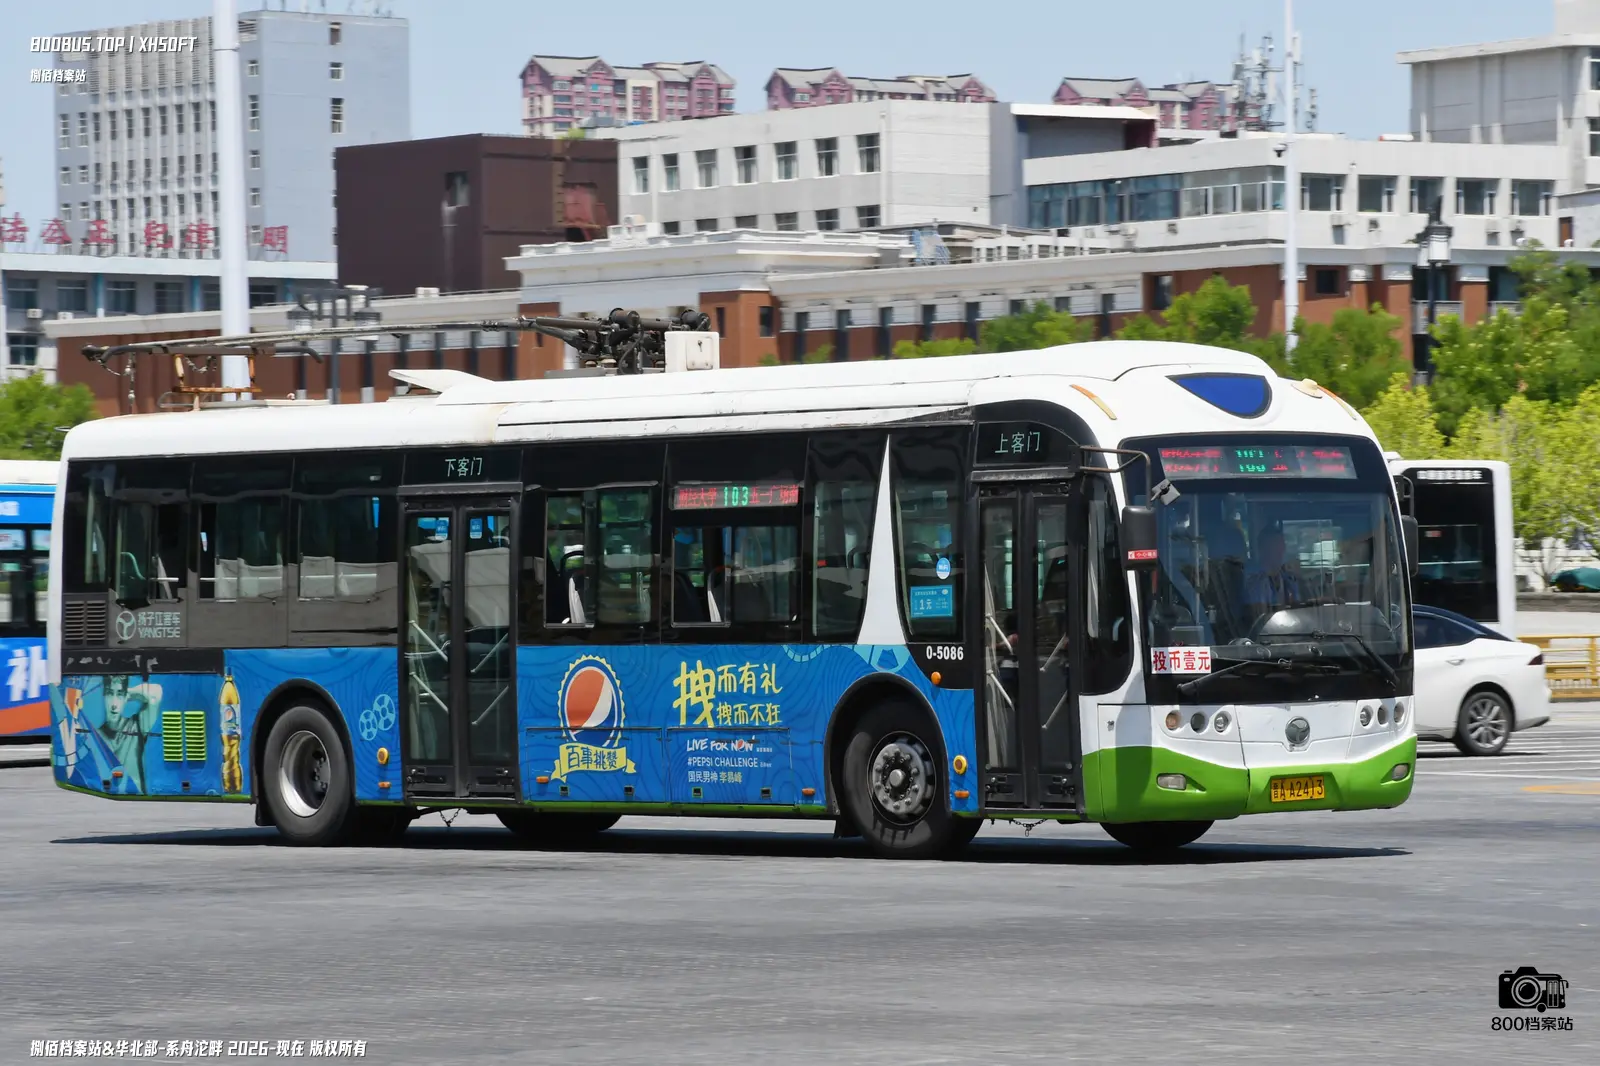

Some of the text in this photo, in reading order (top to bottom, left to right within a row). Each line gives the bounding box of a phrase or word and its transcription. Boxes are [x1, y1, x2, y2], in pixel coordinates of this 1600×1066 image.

[994, 431, 1041, 454] 上客门
[444, 456, 483, 477] 下客门
[723, 485, 749, 507] 103
[926, 645, 964, 660] 0-5086
[1153, 650, 1211, 671] 投币壹元
[686, 738, 708, 752] LIVE
[687, 757, 714, 767] #PEPSI
[714, 757, 758, 768] CHALLENGE
